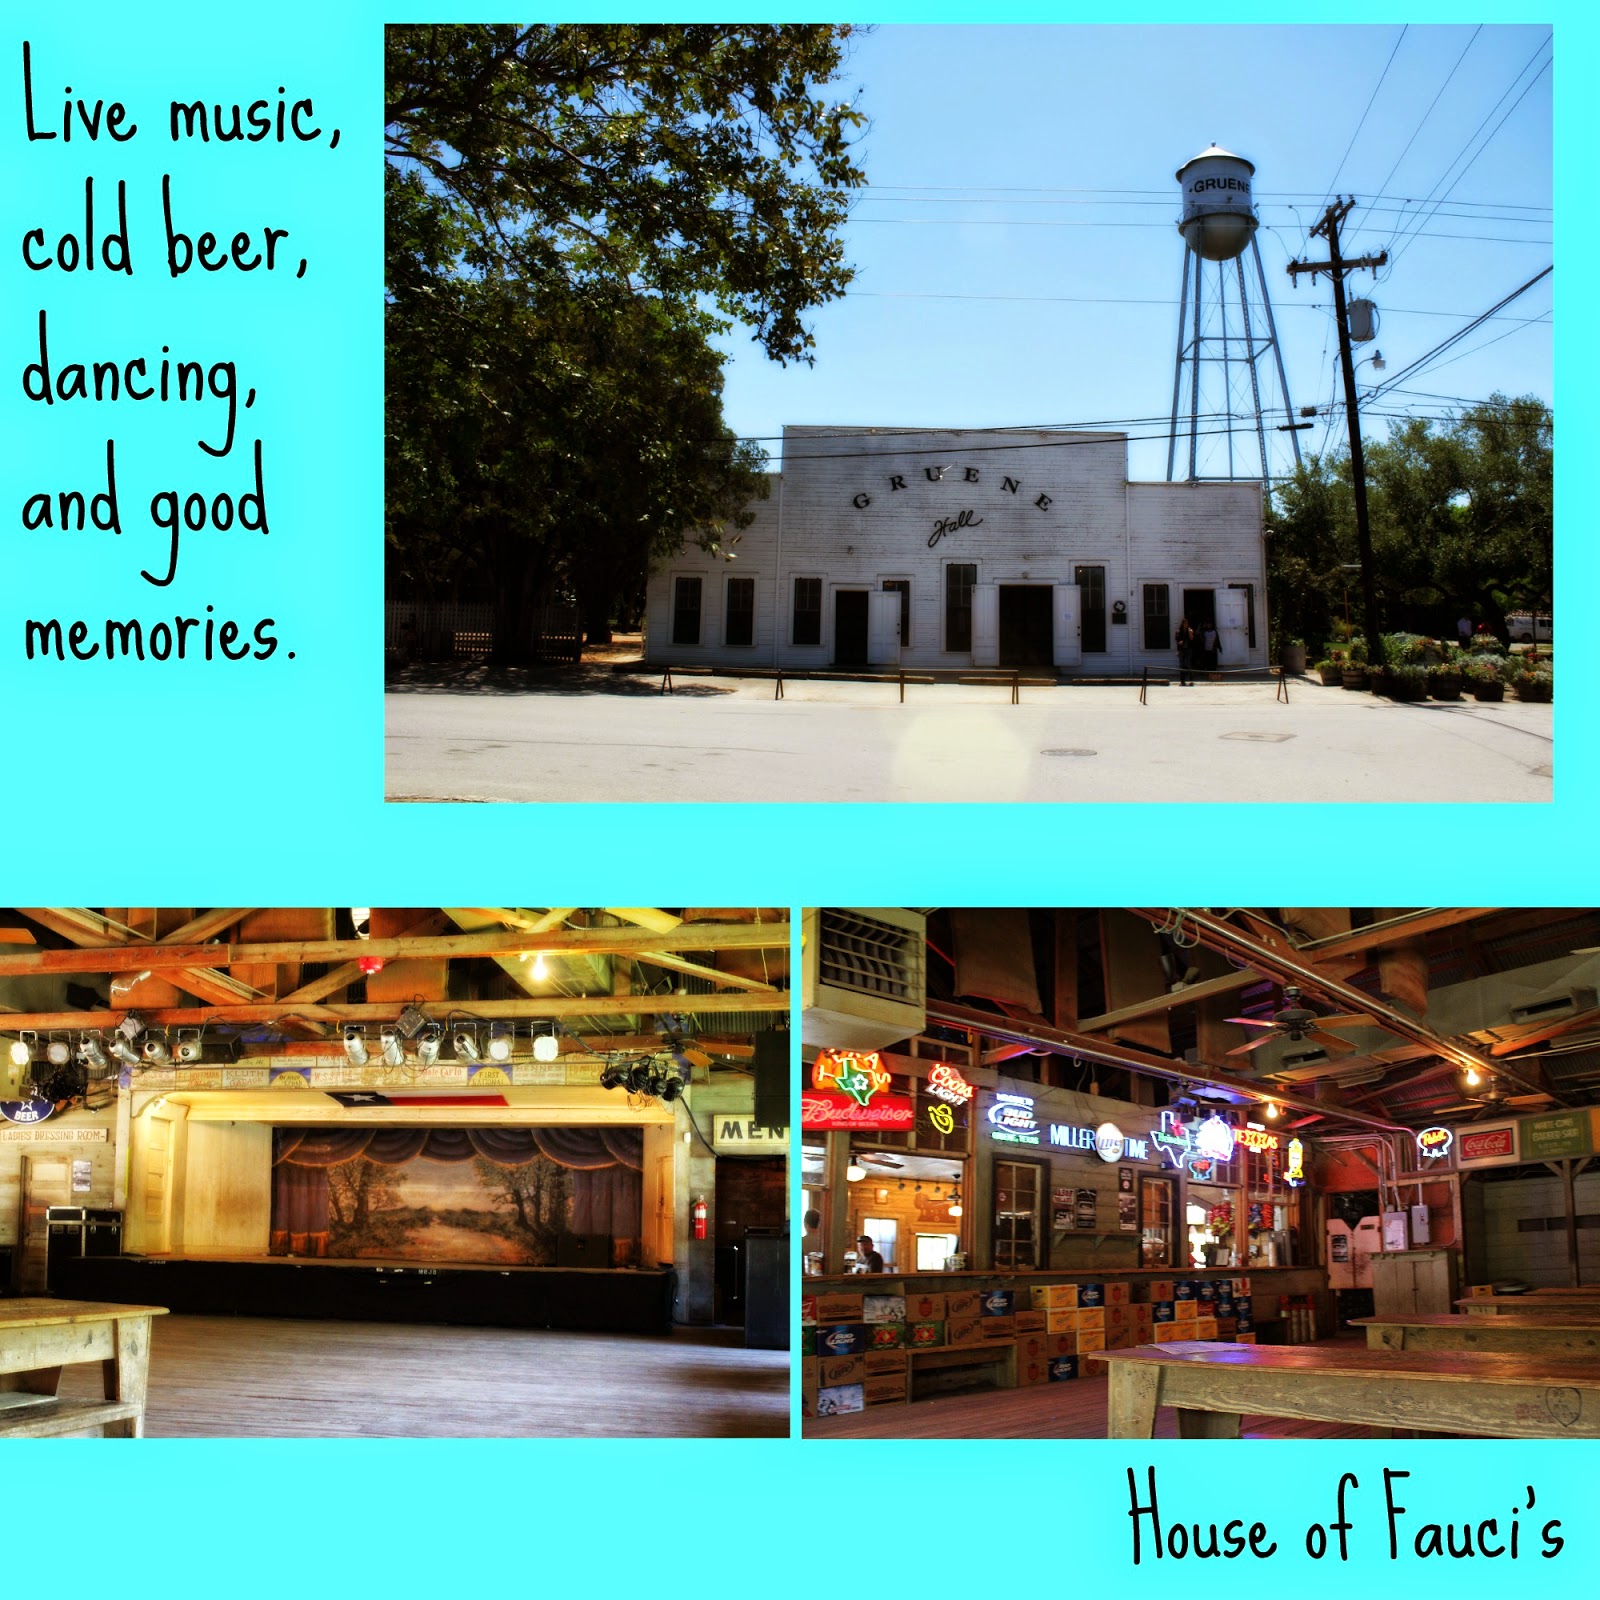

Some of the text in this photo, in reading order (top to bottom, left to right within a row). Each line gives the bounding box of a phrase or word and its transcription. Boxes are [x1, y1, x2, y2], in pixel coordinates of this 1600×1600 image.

[852, 465, 1053, 512] GRUENE
[927, 509, 984, 548] Hall
[931, 1063, 974, 1098] Coors
[926, 1083, 969, 1106] LIGHT
[13, 1110, 40, 1121] BEER
[801, 1098, 915, 1122] Budweiser
[996, 1114, 1038, 1129] LIGHT
[1004, 1107, 1034, 1120] BUD
[2, 1131, 100, 1141] LADIES DRESSING ROOM
[720, 1120, 785, 1139] MEN
[1050, 1123, 1097, 1151] MILLER
[1122, 1136, 1149, 1160] TIME
